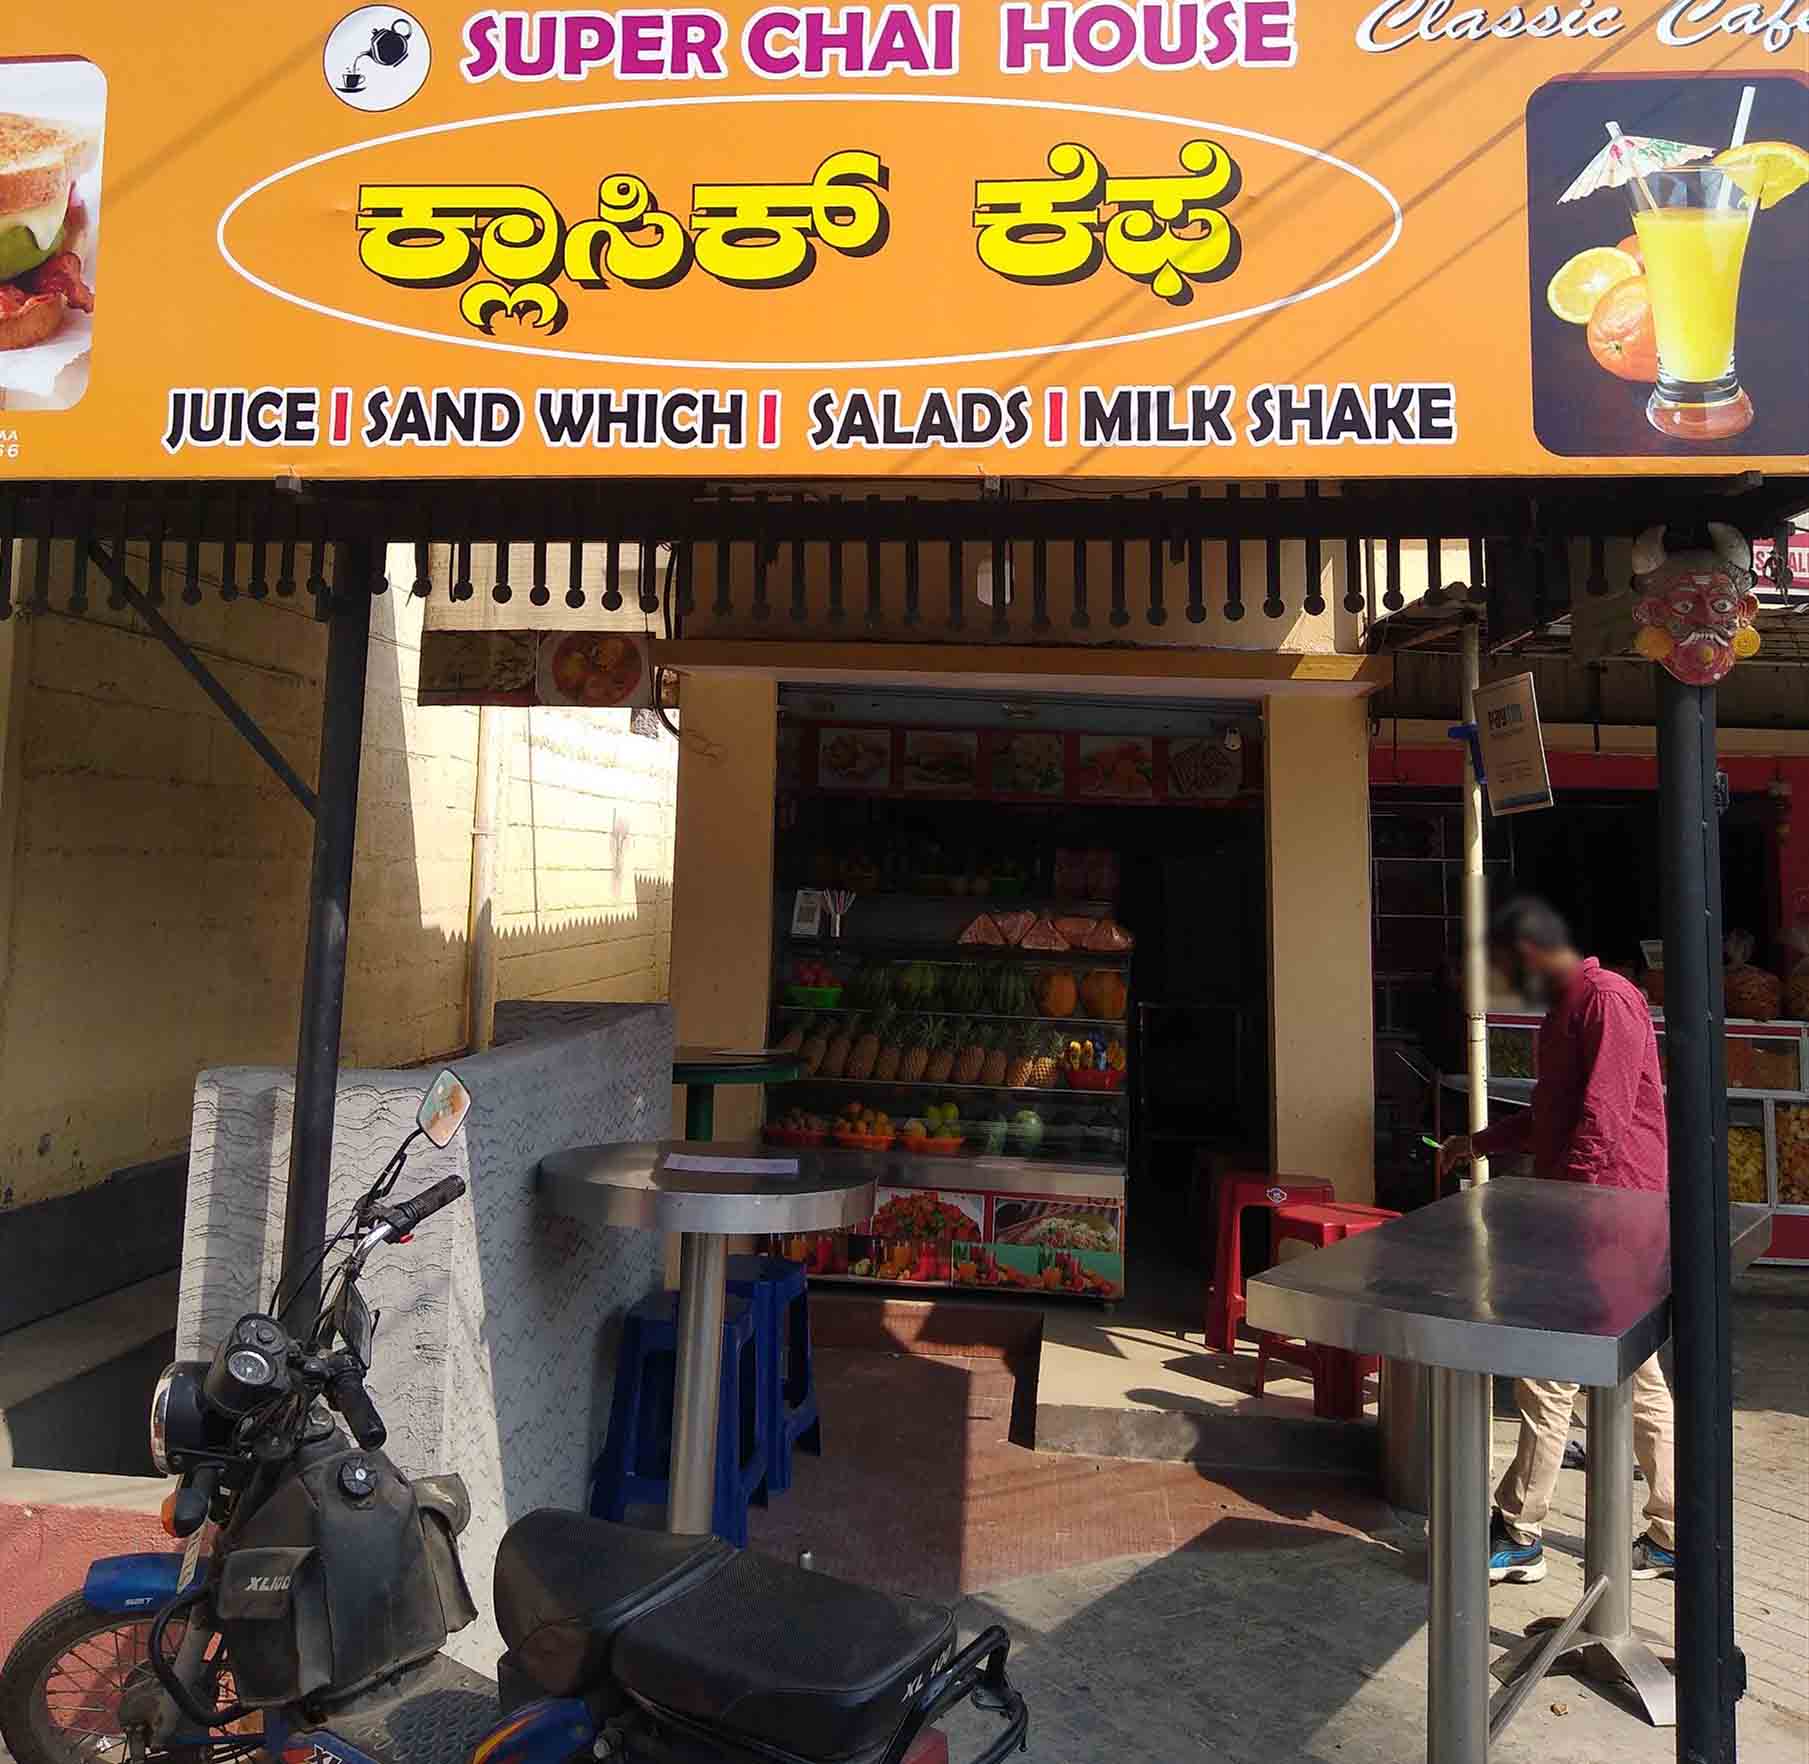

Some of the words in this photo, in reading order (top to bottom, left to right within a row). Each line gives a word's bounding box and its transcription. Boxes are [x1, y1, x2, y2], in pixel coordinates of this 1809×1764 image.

[464, 14, 726, 79] SUPER
[746, 8, 957, 73] CHAI
[1004, 2, 1295, 69] HOUSE
[1355, 0, 1624, 53] Classic
[356, 149, 889, 336] ಕ್ಲಾಸಿಕ್
[165, 389, 316, 450] JUICE
[364, 388, 520, 444] SAND
[539, 389, 742, 448] WHICH
[812, 391, 1029, 448] SALADS
[1084, 390, 1233, 444] MILK
[1250, 387, 1455, 442] SHAKE
[901, 1672, 924, 1702] XL
